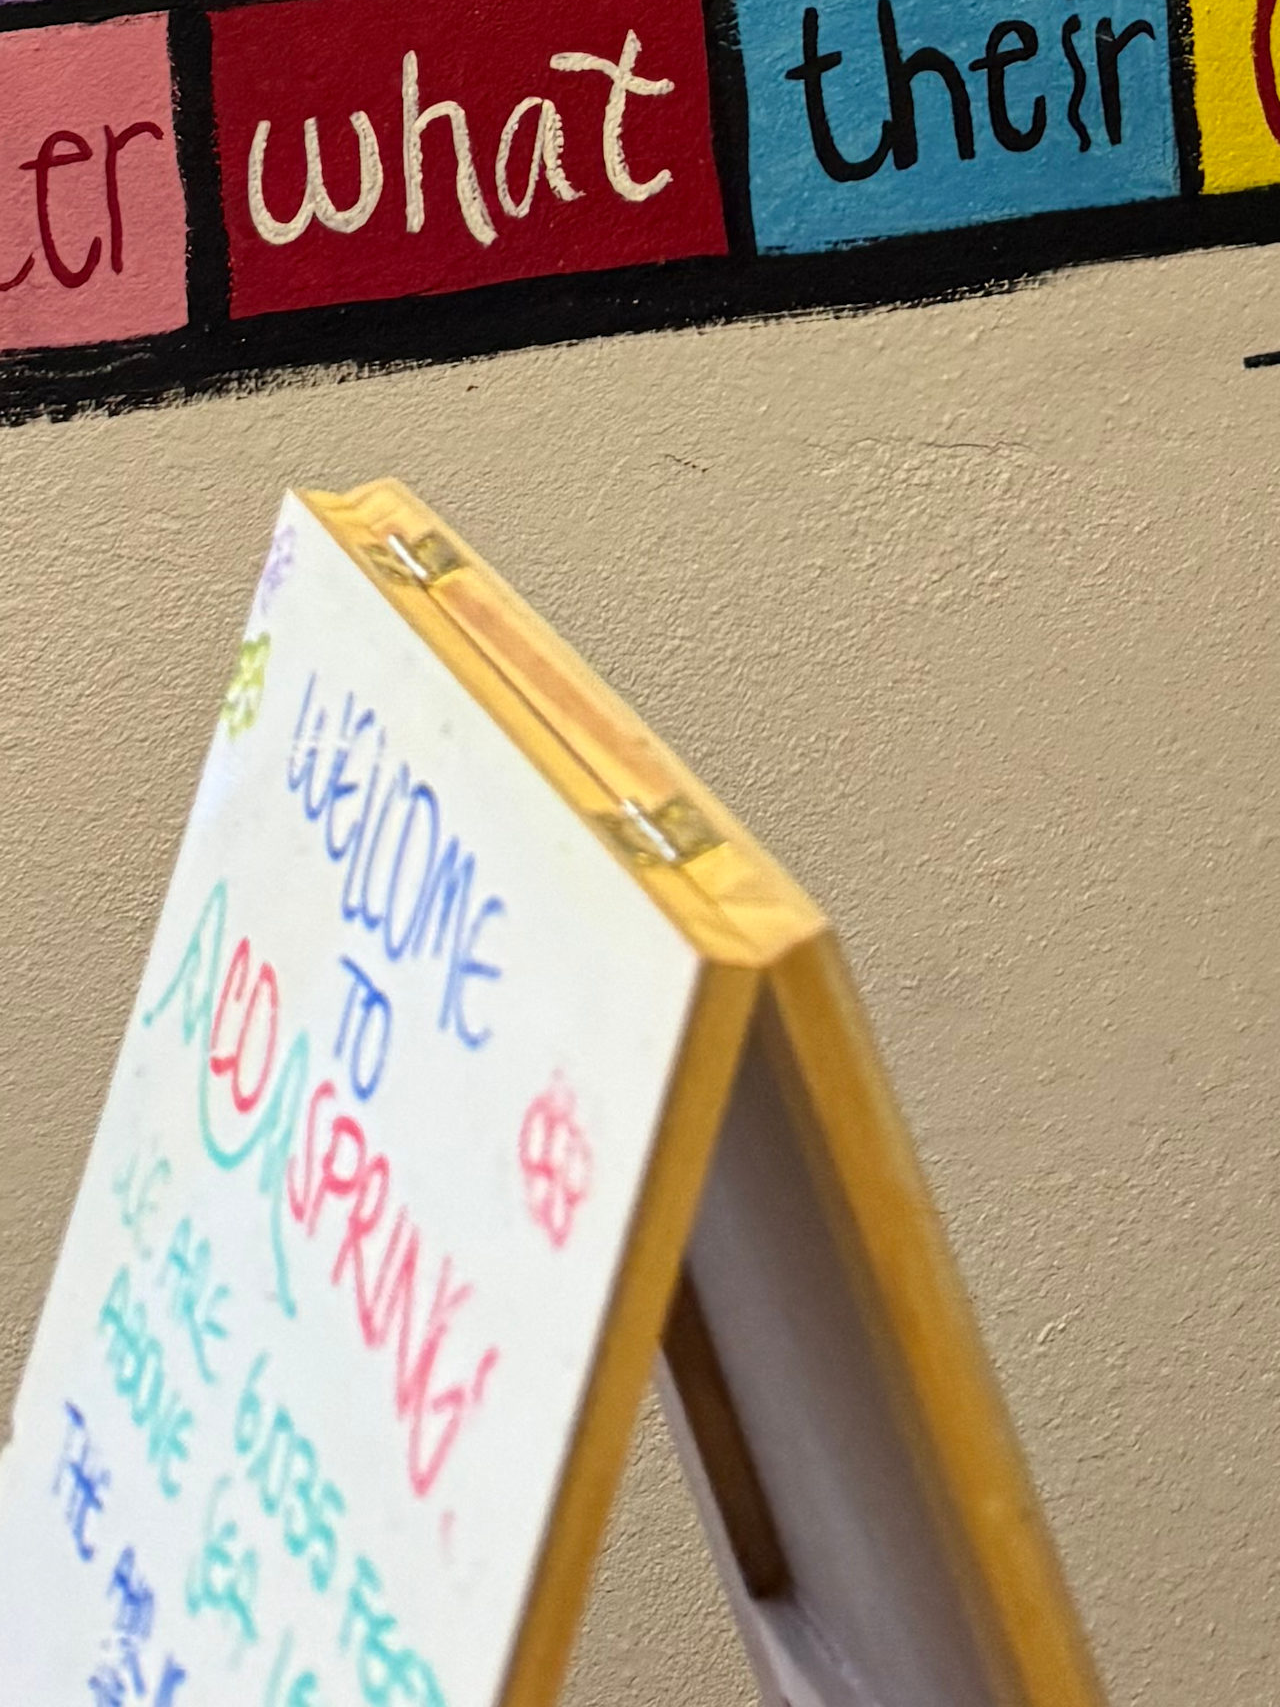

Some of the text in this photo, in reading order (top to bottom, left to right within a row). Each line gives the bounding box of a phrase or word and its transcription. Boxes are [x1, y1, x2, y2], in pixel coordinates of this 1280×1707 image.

[246, 28, 676, 249] what
[286, 669, 507, 1053] WELCOME
[332, 953, 394, 1103] TO
